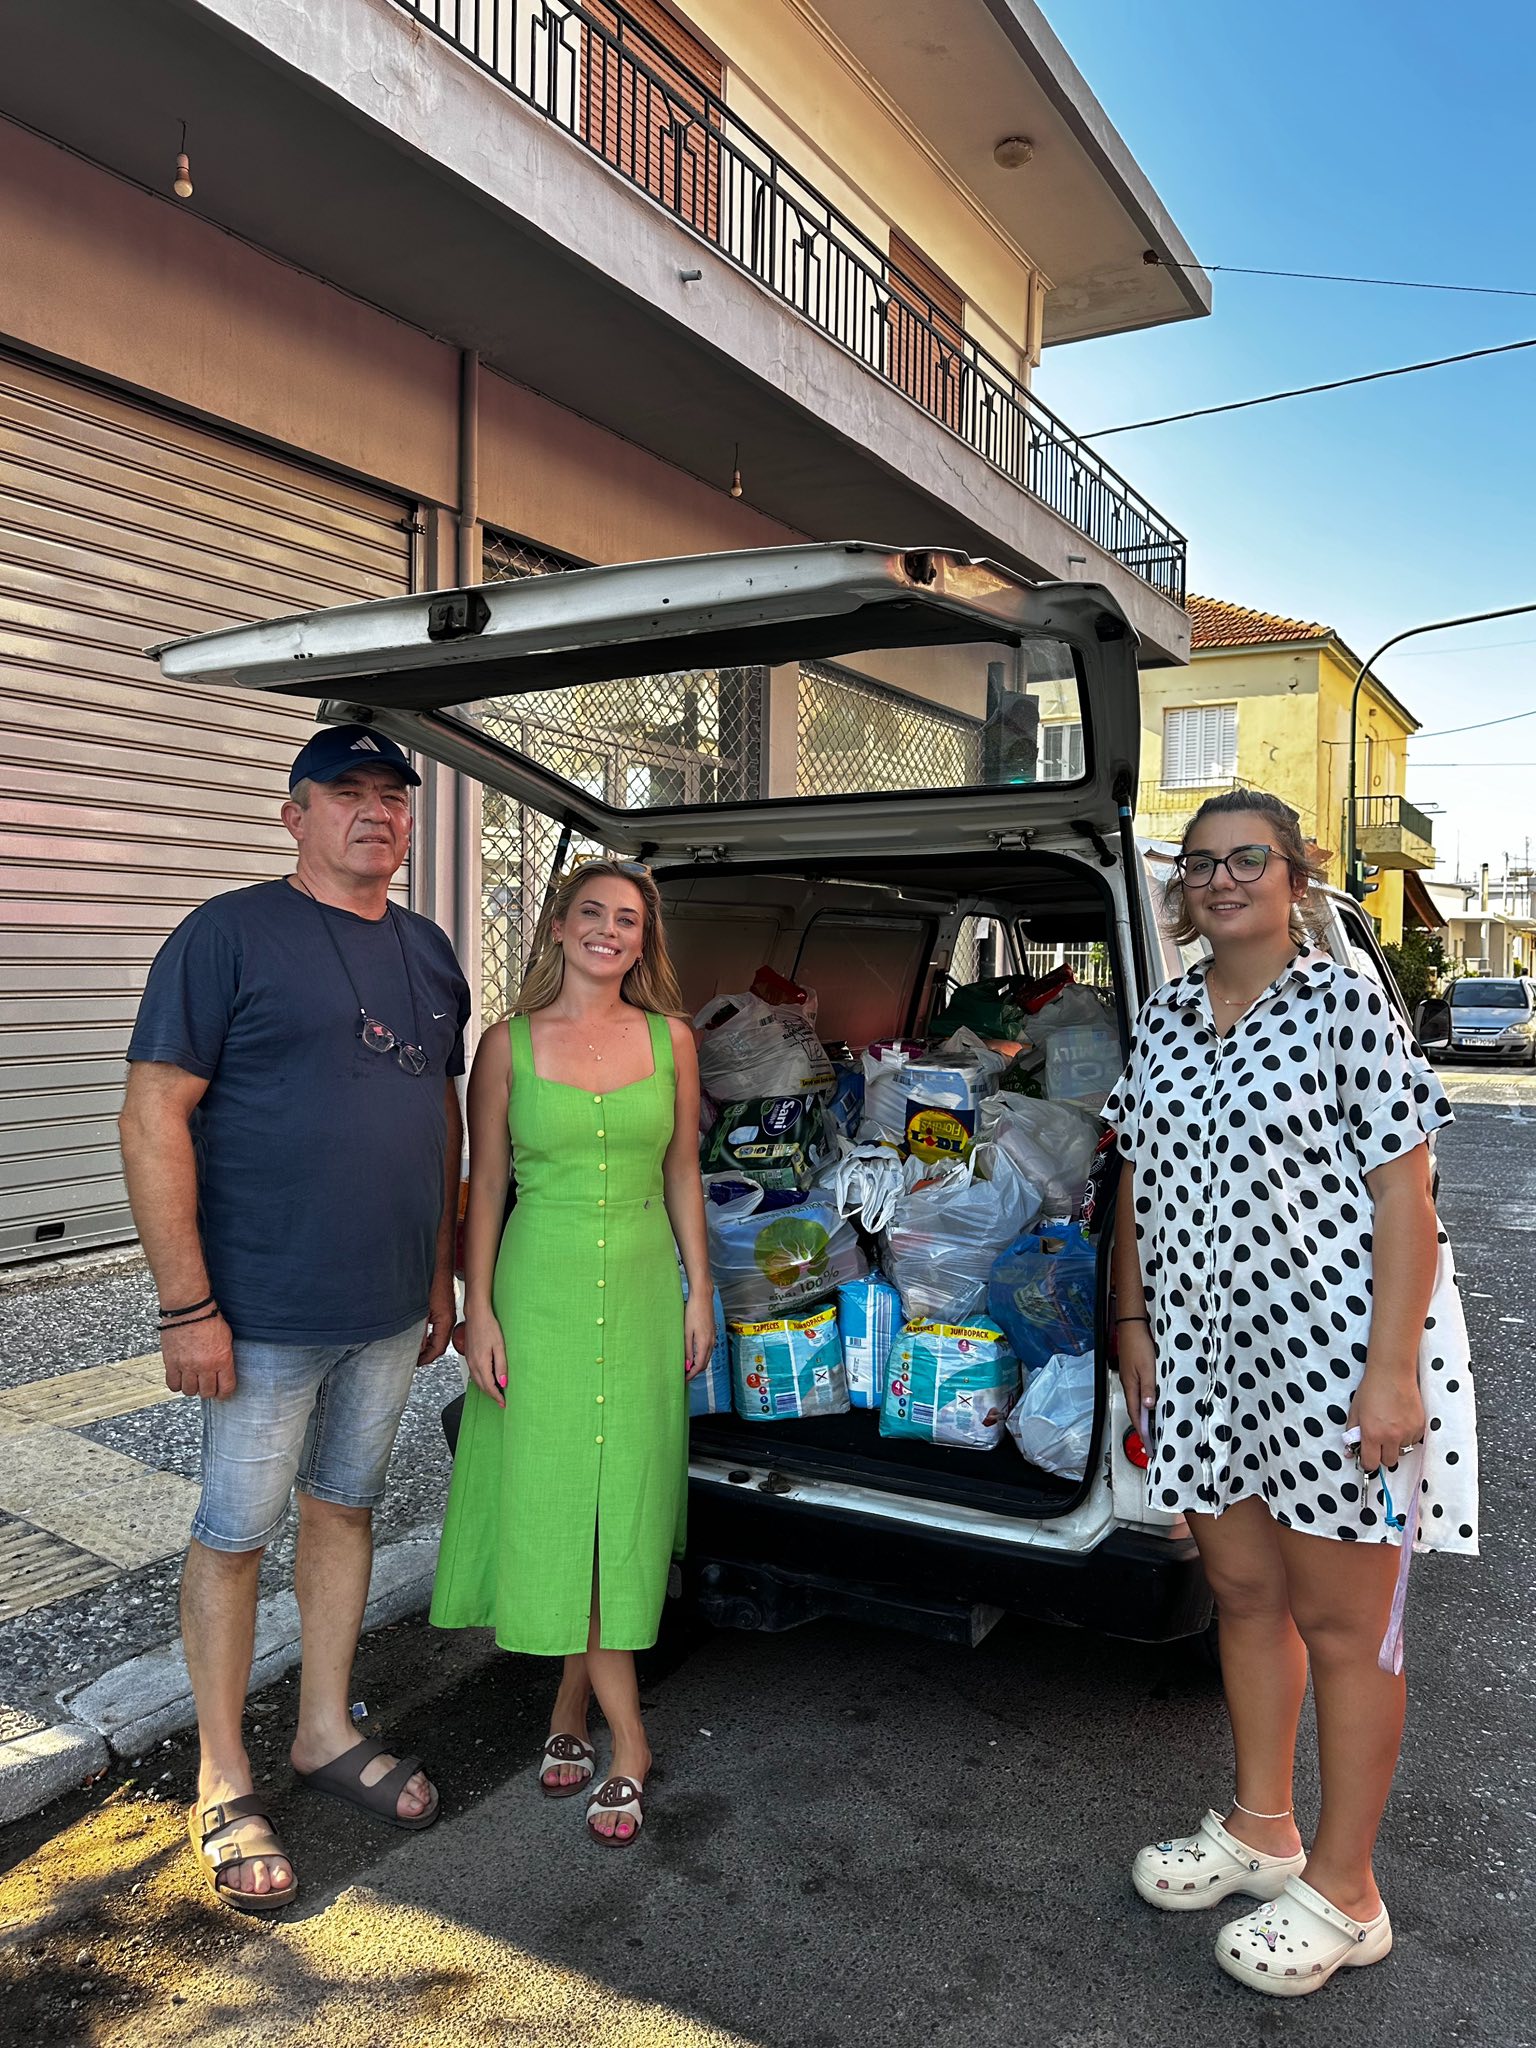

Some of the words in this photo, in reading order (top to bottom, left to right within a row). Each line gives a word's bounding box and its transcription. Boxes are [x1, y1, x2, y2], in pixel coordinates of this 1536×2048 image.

[774, 1100, 795, 1129] Sani
[800, 1265, 839, 1293] 100%
[950, 1328, 989, 1339] JUMBOPACK
